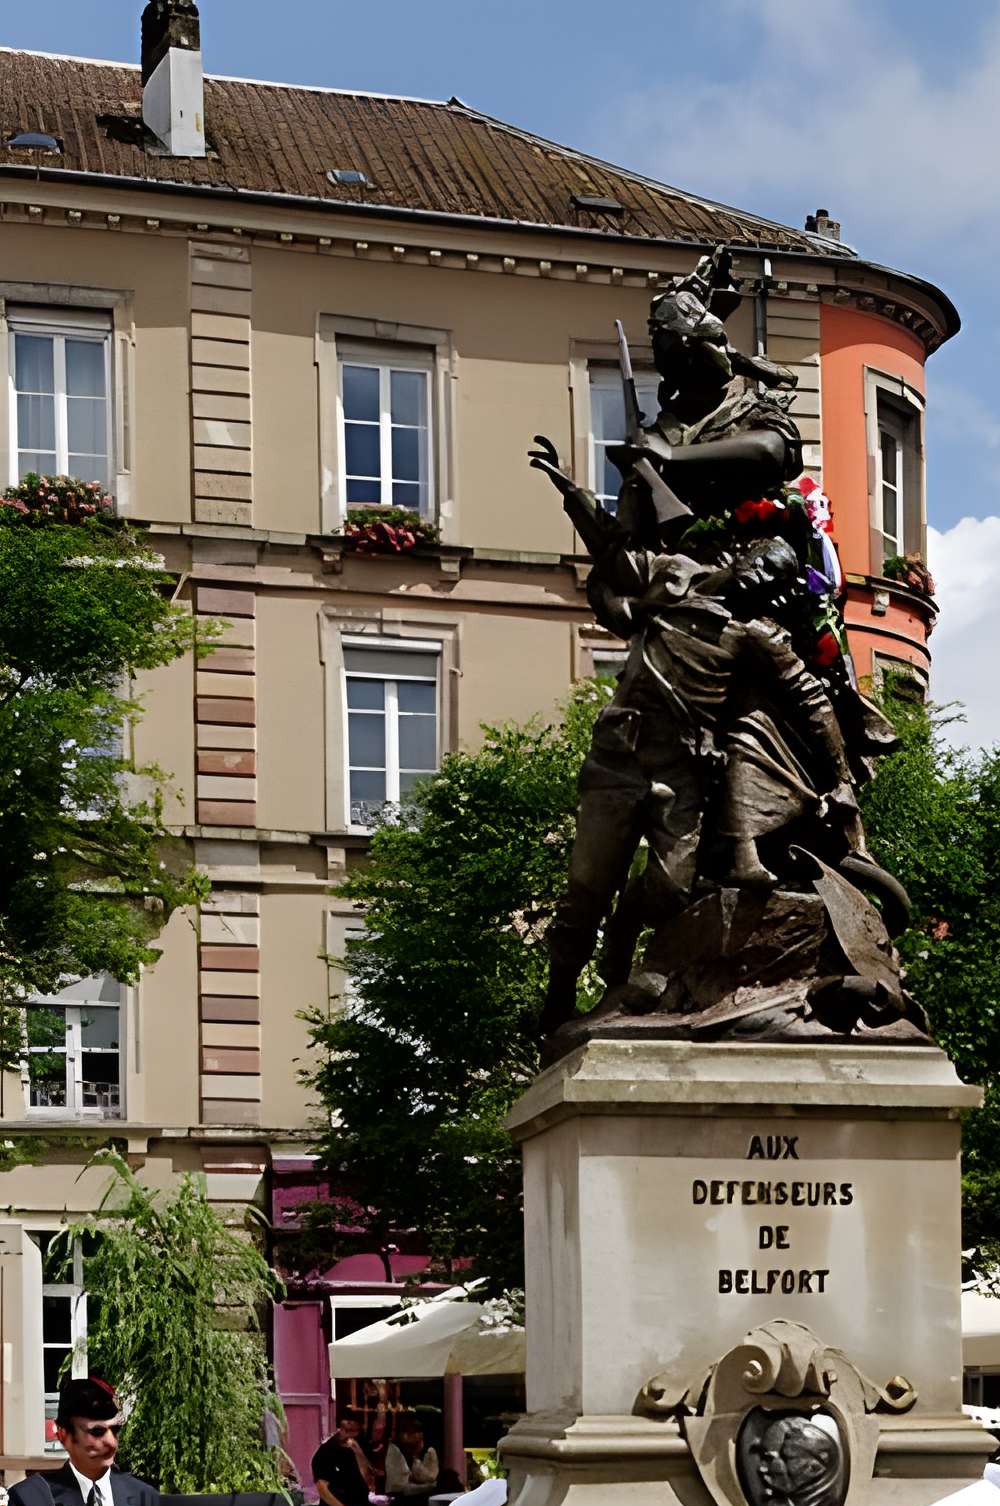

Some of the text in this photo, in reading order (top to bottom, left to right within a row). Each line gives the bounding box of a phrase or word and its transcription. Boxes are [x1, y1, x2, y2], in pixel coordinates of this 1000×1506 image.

[747, 1135, 800, 1160] AUX
[692, 1179, 854, 1206] DEFENSEURS
[758, 1225, 790, 1249] DE
[718, 1269, 829, 1294] BELFORT
